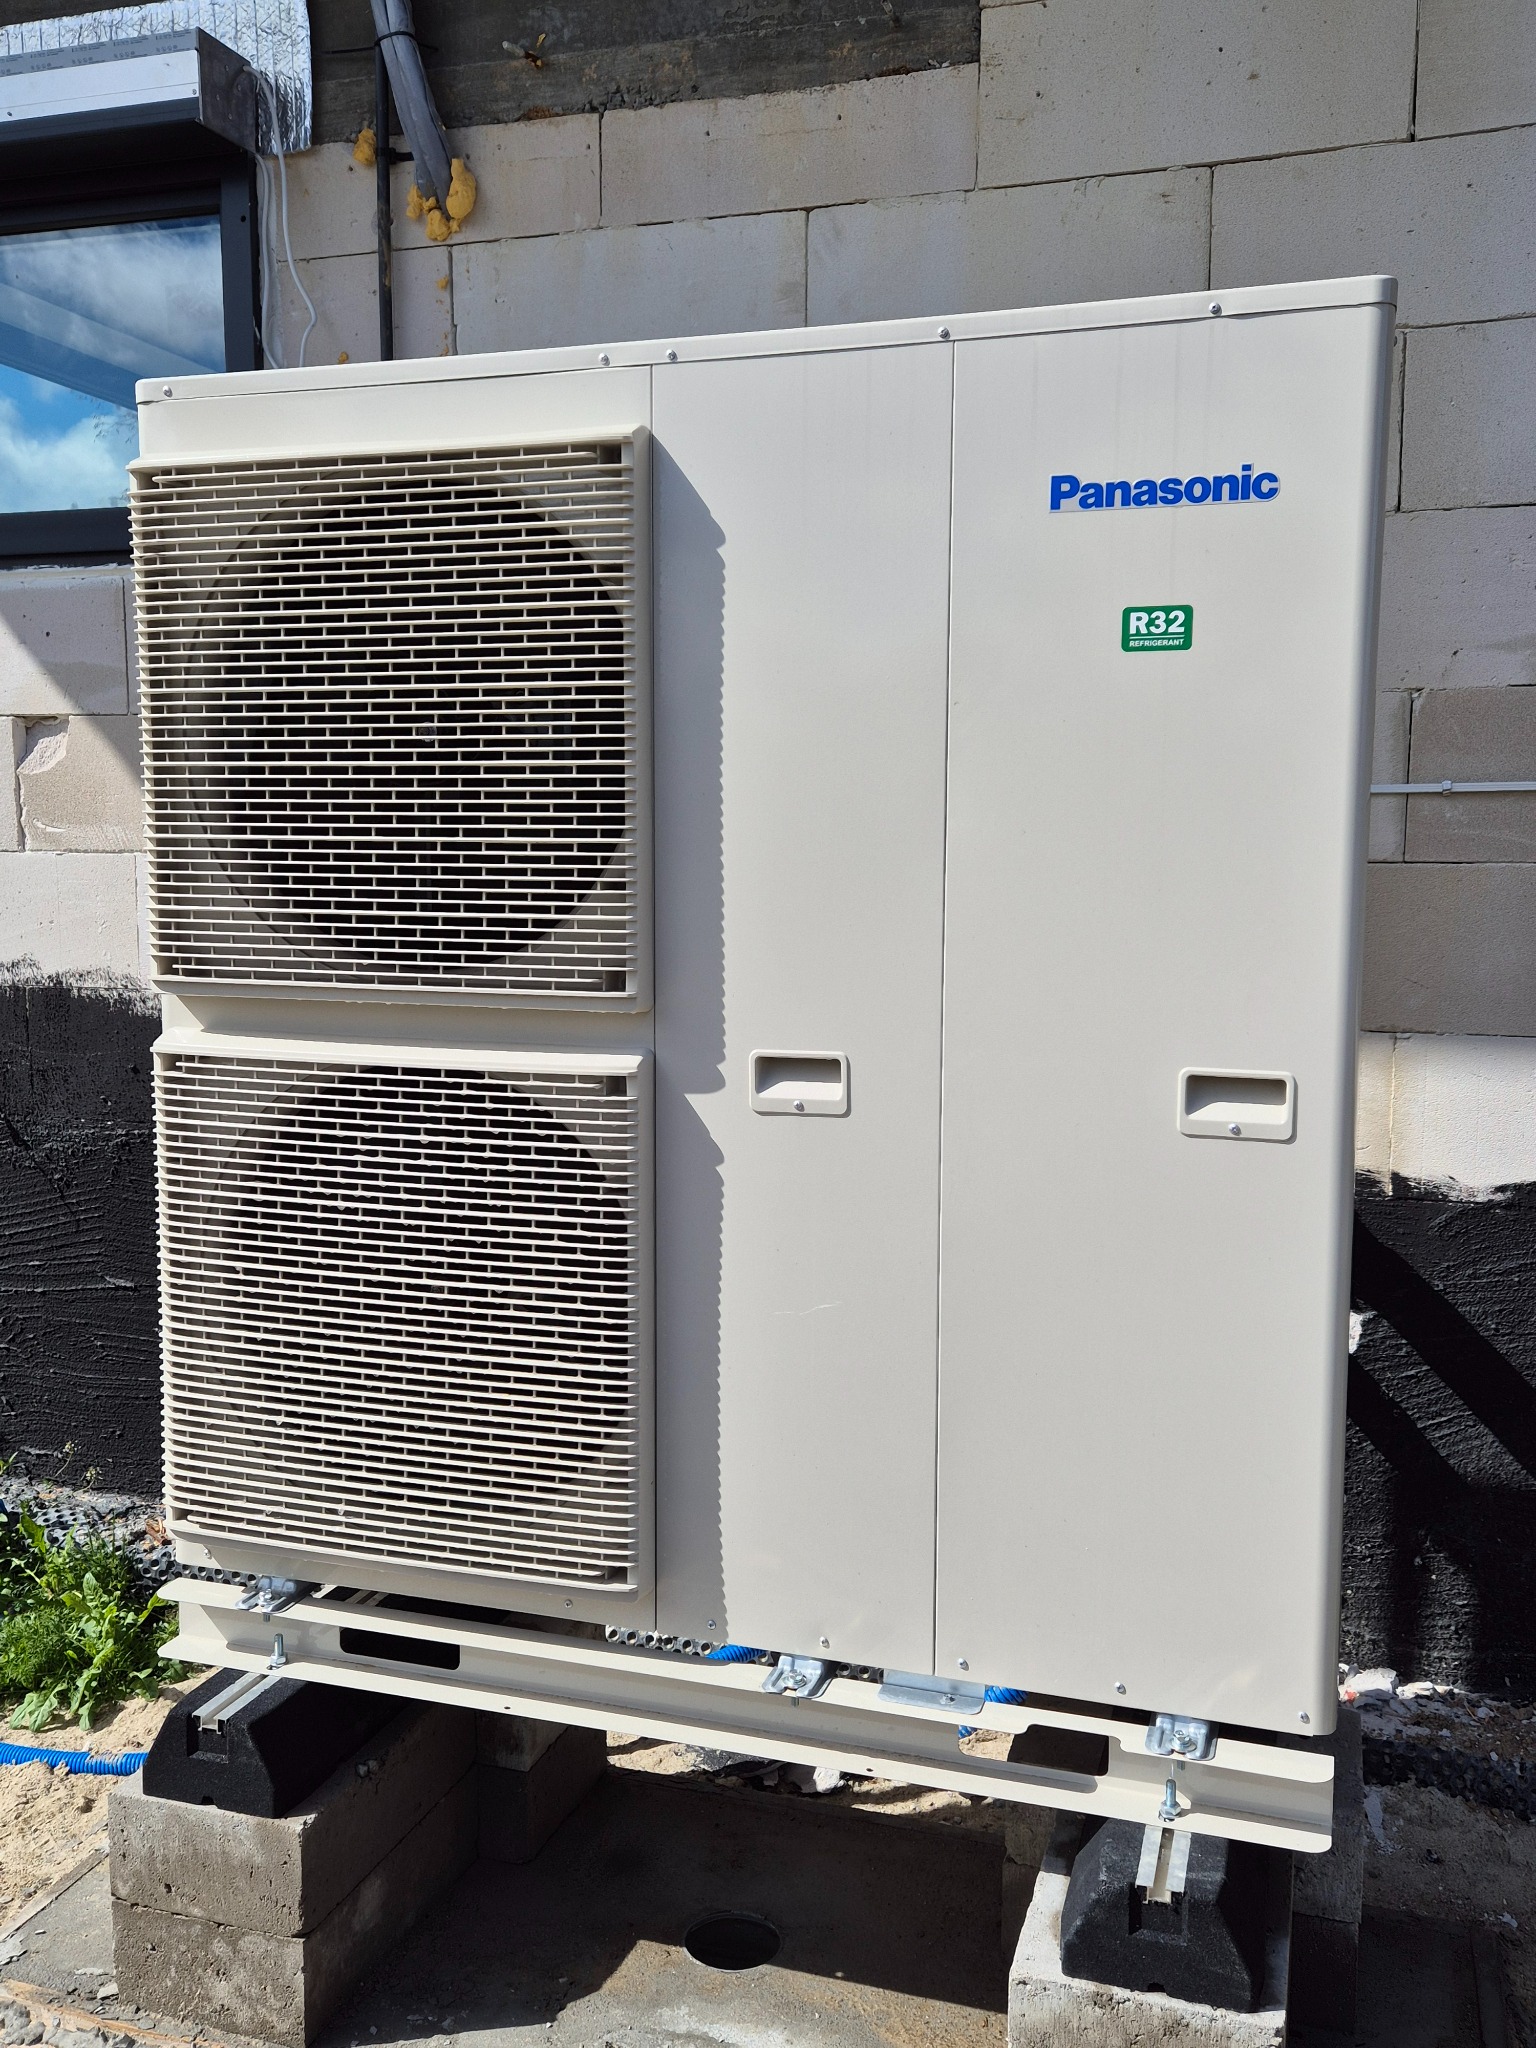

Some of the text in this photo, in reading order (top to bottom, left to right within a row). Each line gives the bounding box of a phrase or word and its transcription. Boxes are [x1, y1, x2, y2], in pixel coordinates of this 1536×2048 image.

[1050, 463, 1279, 511] Panasonic
[1129, 610, 1186, 635] R32
[1129, 638, 1185, 647] REFRIGERANT
